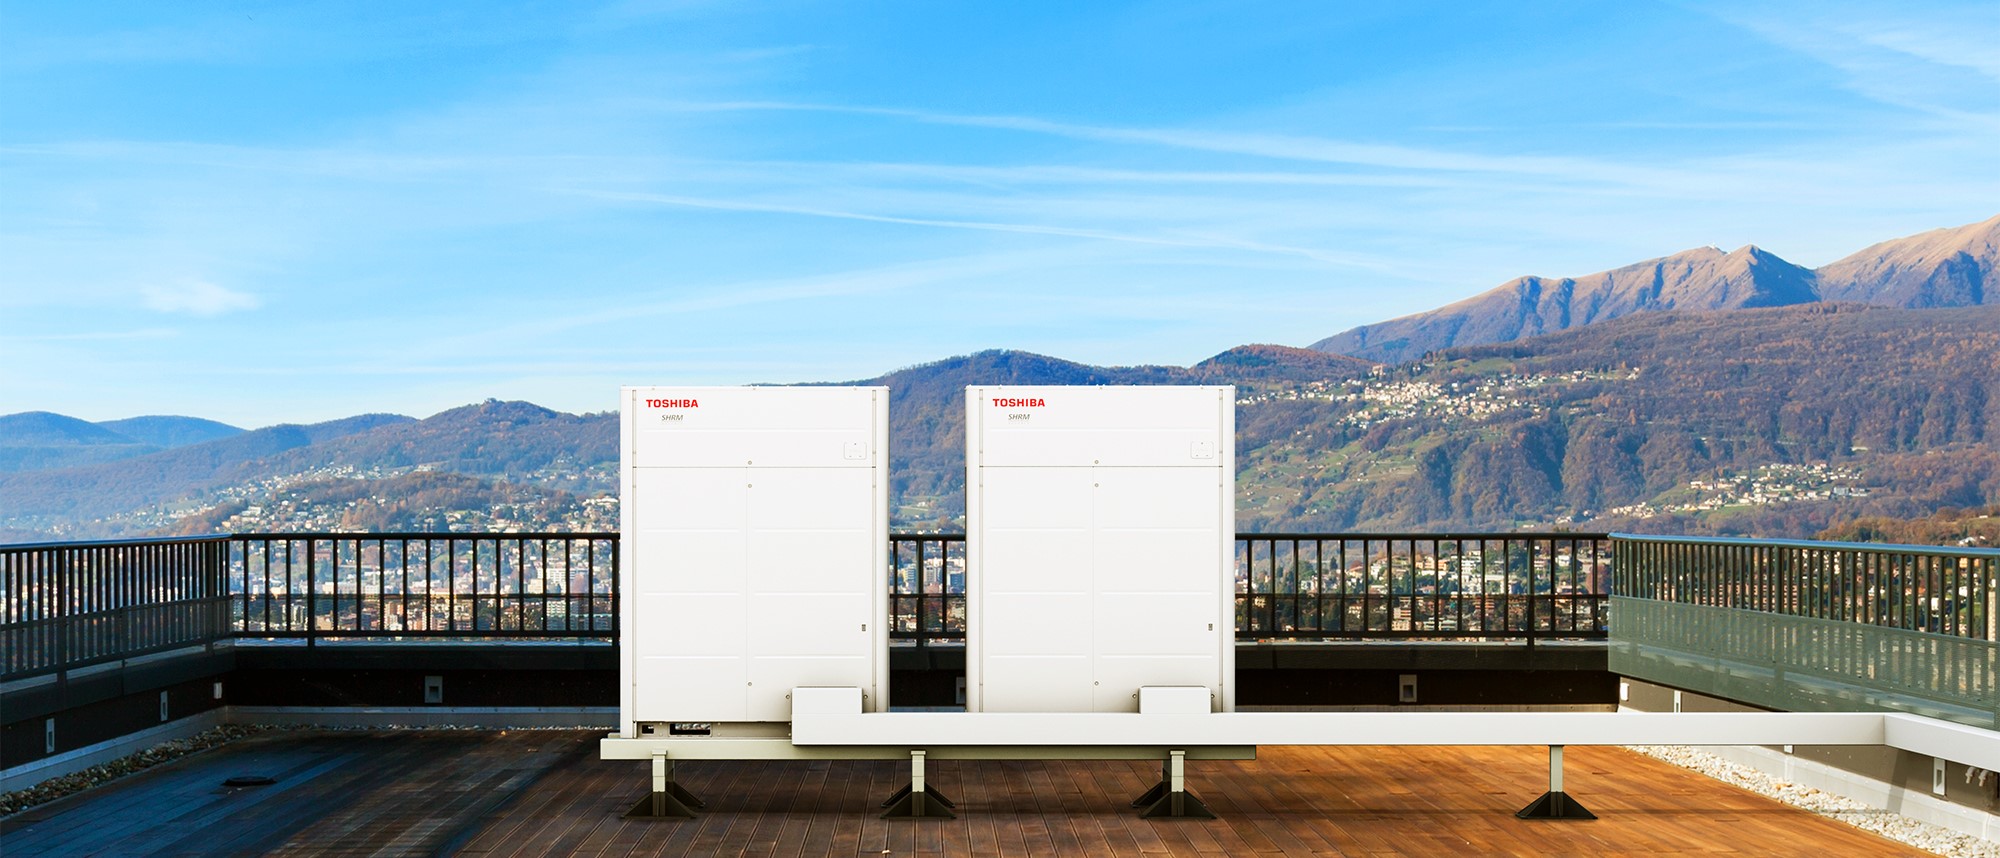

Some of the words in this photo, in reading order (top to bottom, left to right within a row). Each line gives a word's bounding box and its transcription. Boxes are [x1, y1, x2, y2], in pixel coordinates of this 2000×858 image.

[645, 399, 699, 408] TOSHIBA
[992, 398, 1046, 408] TOSHIBA
[1008, 413, 1031, 421] SHRM
